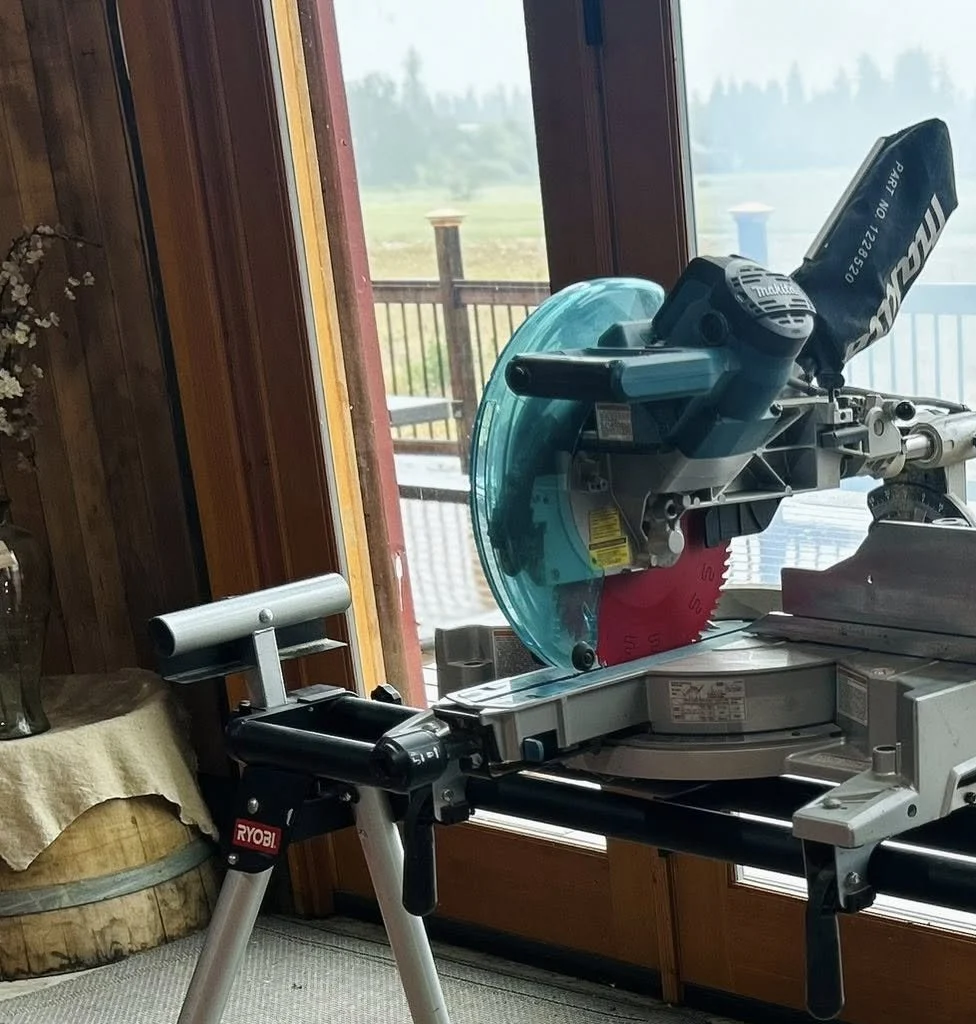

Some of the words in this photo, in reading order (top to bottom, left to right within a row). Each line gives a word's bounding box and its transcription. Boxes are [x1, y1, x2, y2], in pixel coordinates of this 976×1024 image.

[885, 160, 904, 196] PART
[875, 198, 889, 219] NO.
[844, 224, 879, 284] 1228520
[237, 823, 276, 848] RYOBI
